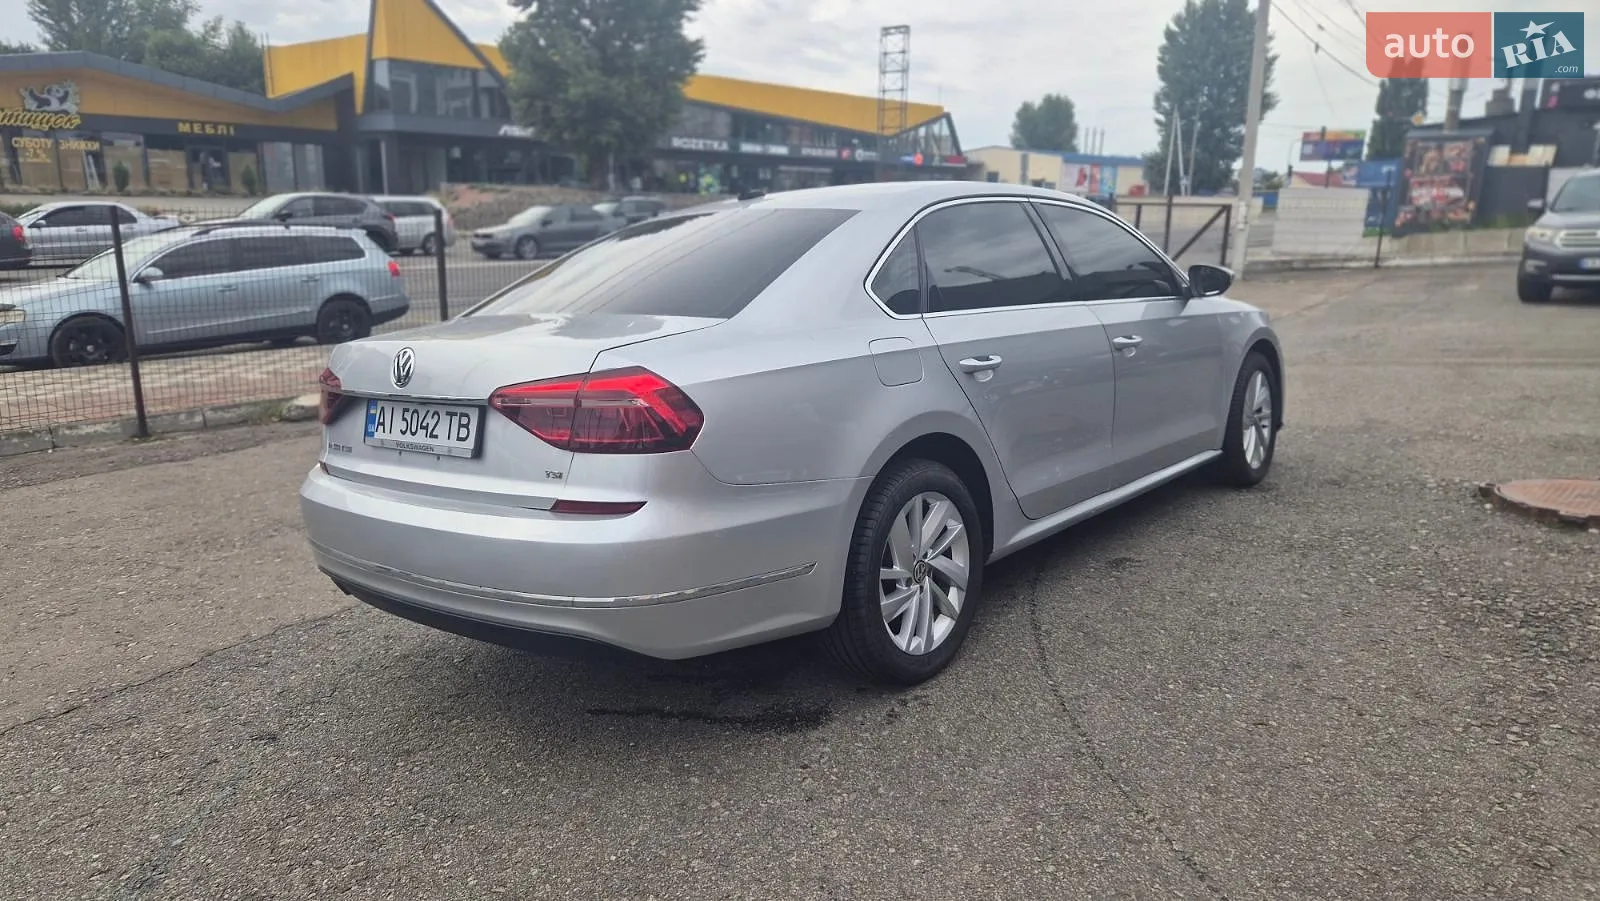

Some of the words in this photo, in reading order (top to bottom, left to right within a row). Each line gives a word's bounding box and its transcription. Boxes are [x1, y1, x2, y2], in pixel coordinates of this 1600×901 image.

[177, 121, 236, 136] МЕБЛІ
[12, 137, 53, 149] СУБОТУ
[60, 139, 100, 151] ЗНИЖКИ
[671, 136, 729, 151] ROZETKA
[376, 406, 395, 434] AI
[400, 407, 441, 439] 5042
[445, 410, 472, 442] TB
[395, 439, 435, 452] VOLKSWAGEN
